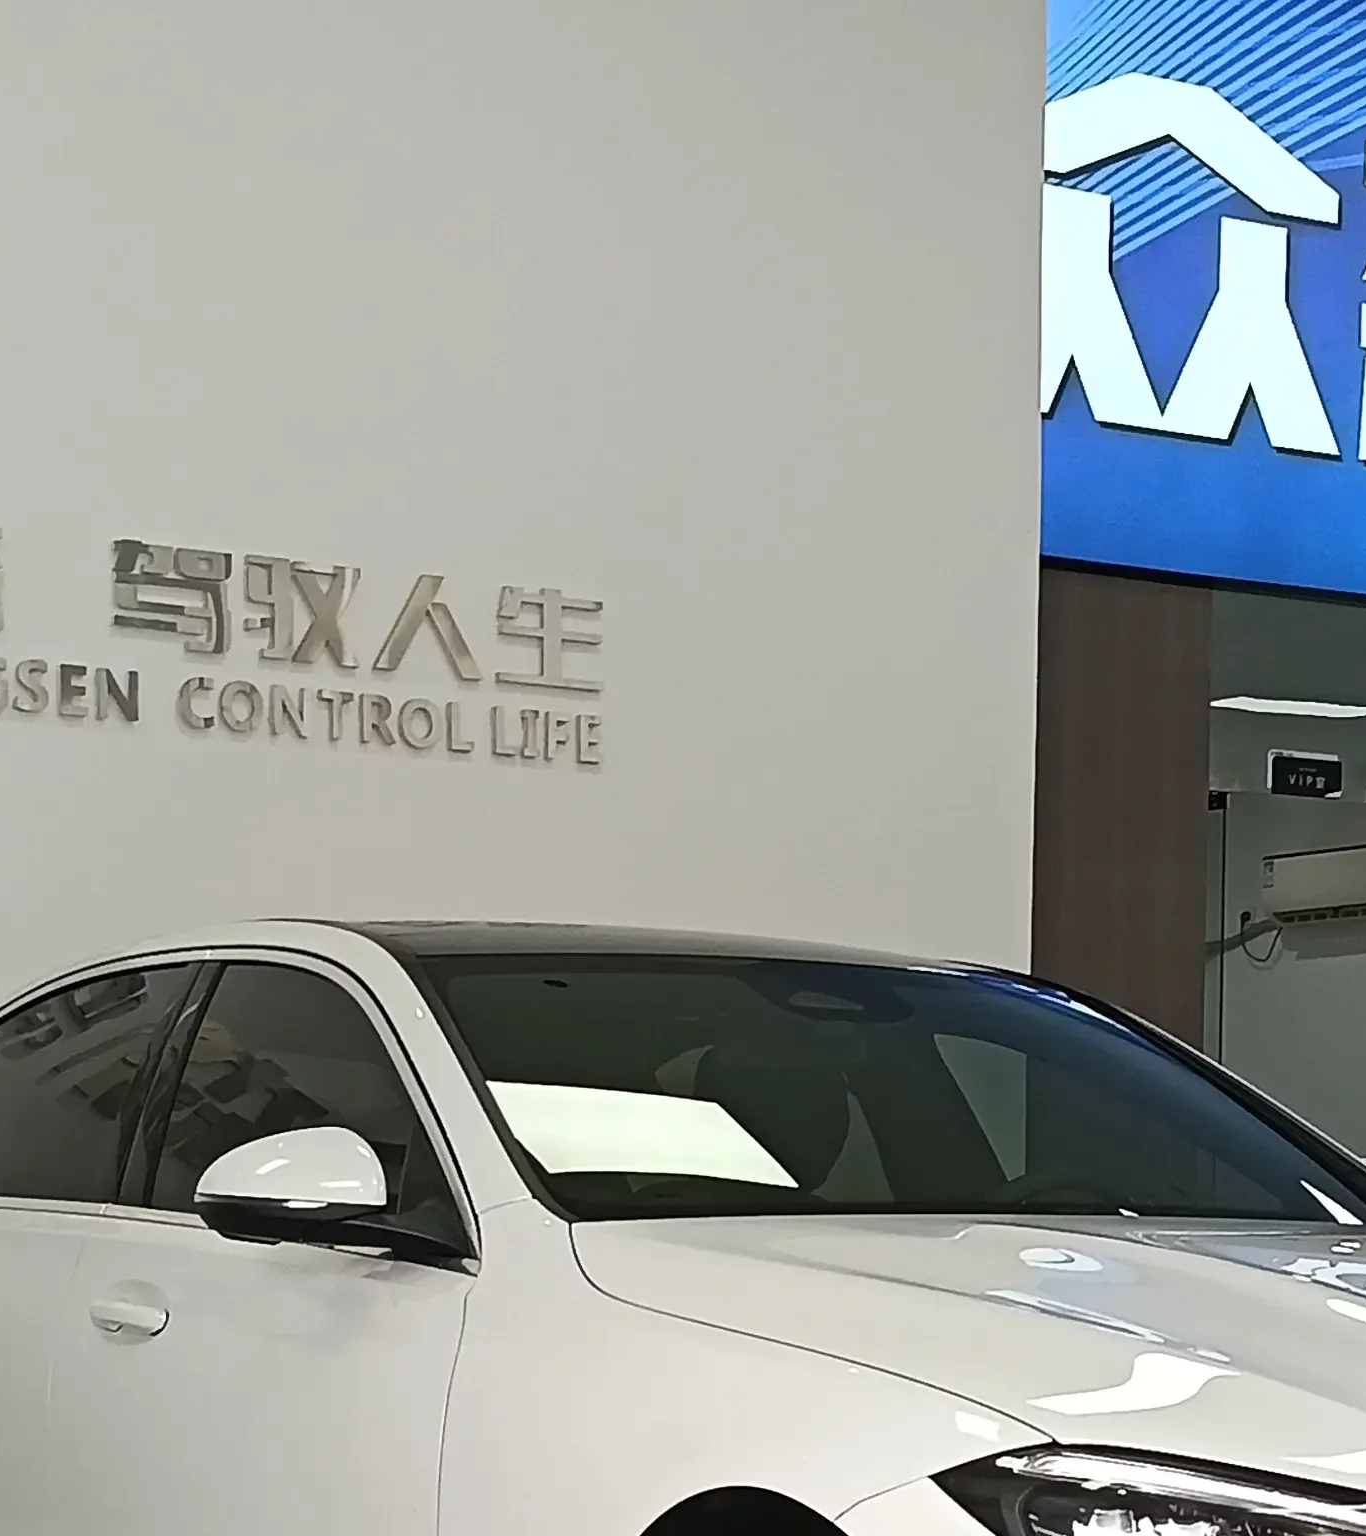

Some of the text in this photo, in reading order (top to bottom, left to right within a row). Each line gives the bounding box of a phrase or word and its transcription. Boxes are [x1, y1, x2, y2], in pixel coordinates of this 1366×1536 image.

[112, 539, 604, 693] 驾驭人生
[178, 676, 475, 755] CONTROL
[490, 705, 603, 765] LIFE
